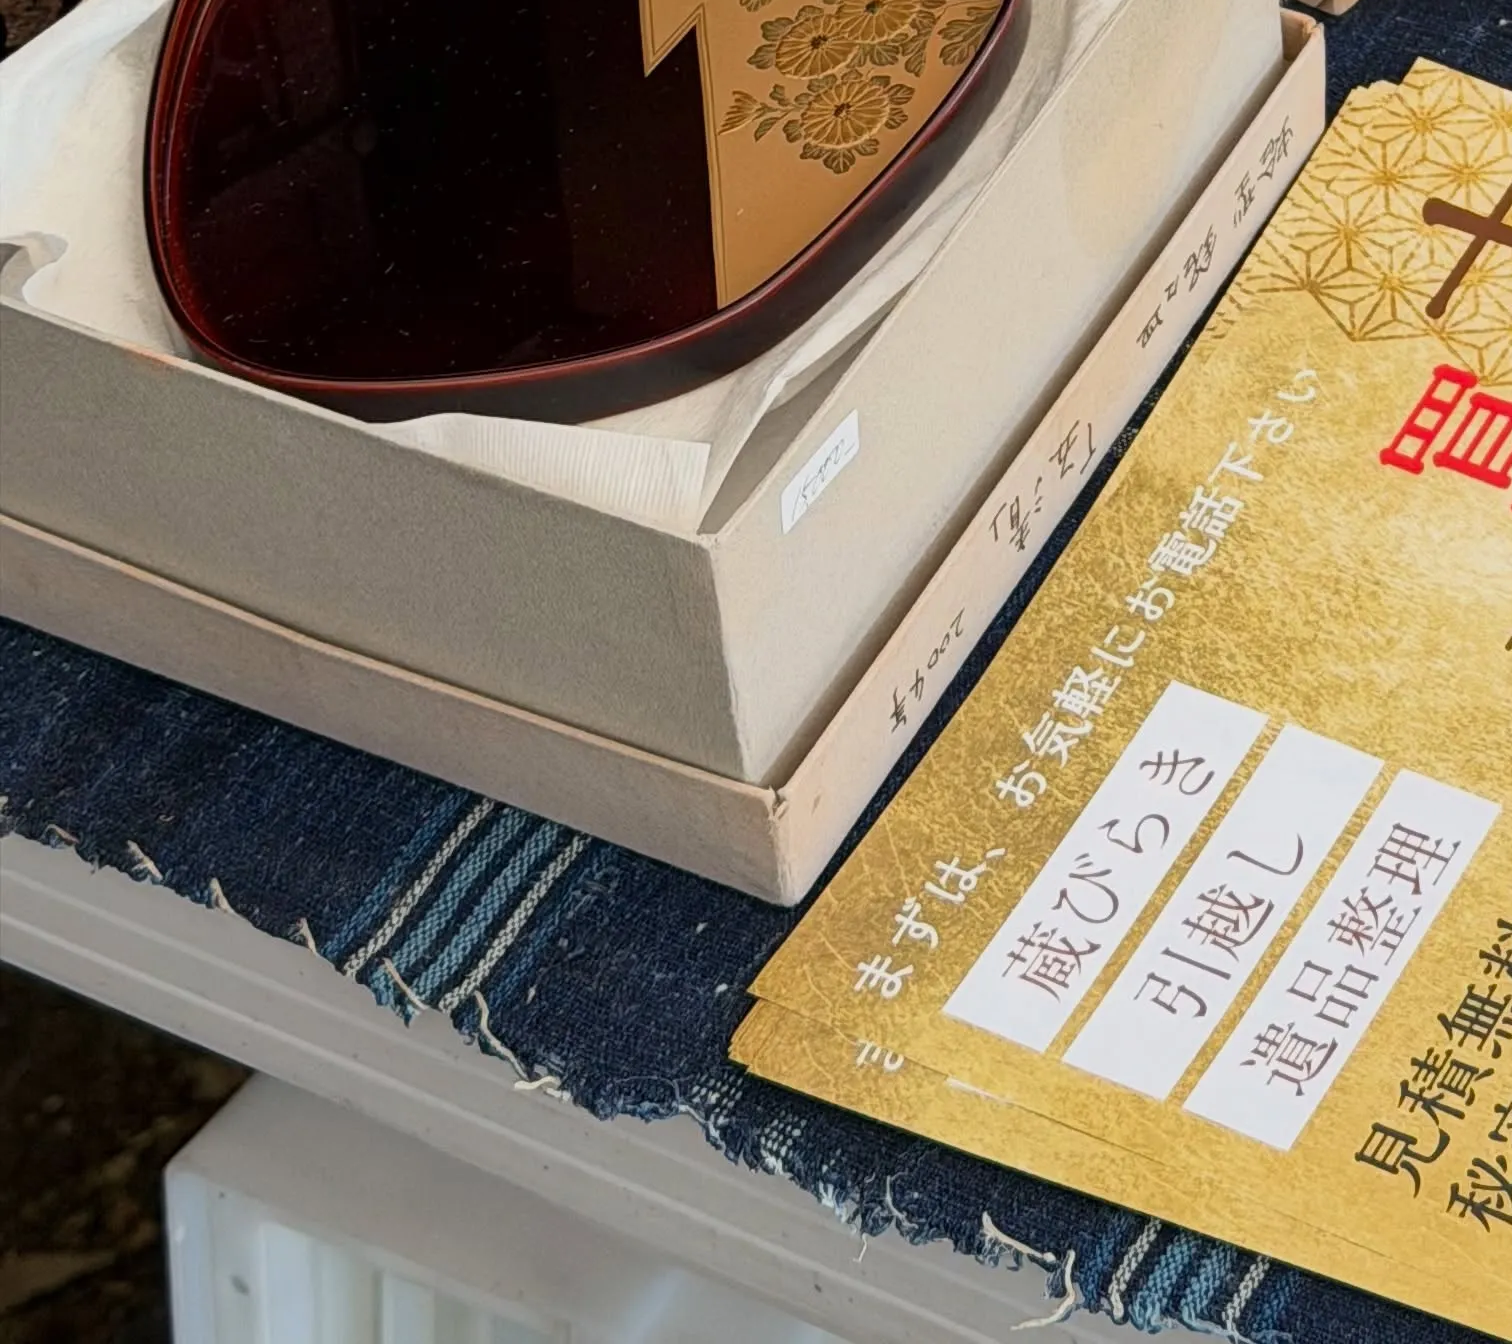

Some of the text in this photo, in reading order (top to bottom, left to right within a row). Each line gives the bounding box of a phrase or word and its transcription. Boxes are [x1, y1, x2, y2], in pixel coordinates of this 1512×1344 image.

[1001, 747, 1217, 1003] 蔵びらき
[1132, 833, 1304, 1019] 引越し
[1240, 822, 1462, 1097] 遺品整理
